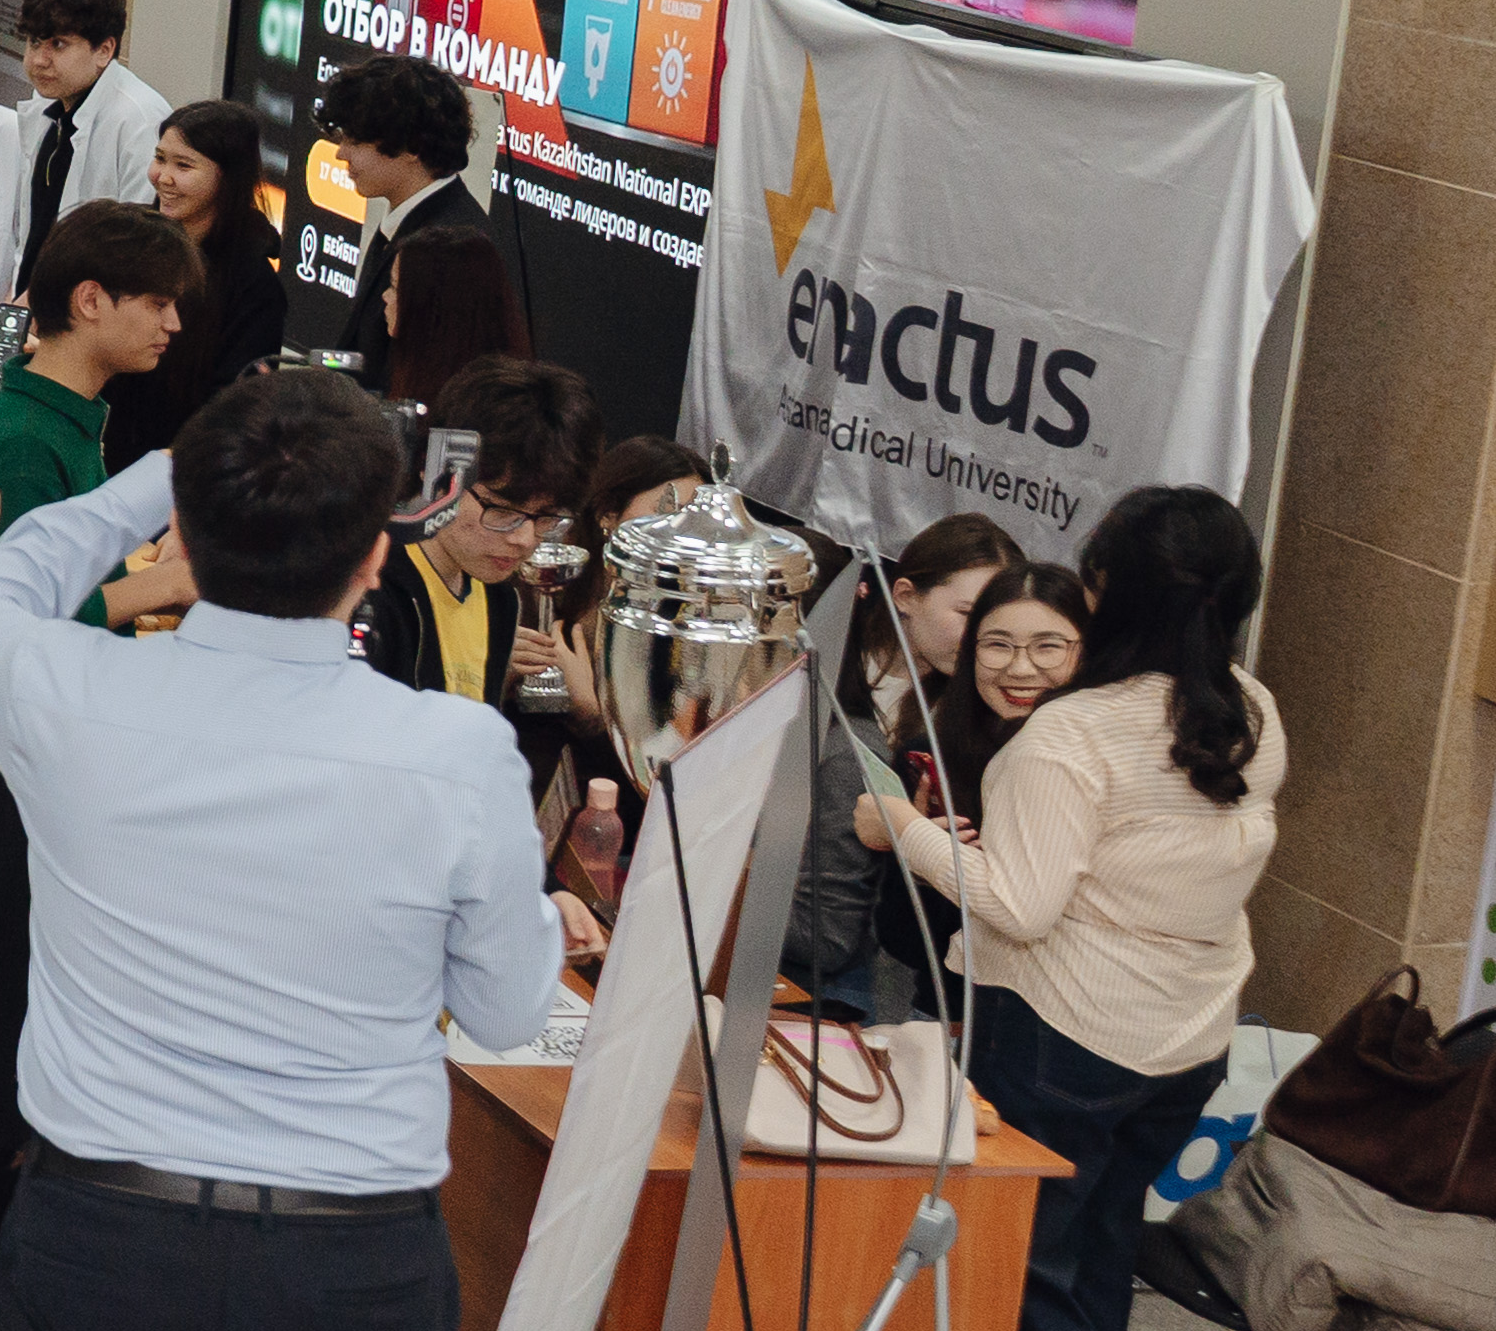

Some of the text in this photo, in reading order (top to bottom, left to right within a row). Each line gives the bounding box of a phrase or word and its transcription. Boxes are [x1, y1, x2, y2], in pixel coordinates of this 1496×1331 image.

[408, 15, 428, 57] В
[431, 22, 567, 108] КОМАНДУ
[319, 160, 331, 181] 17
[496, 124, 532, 156] atus
[532, 130, 613, 185] Kazakhstan
[613, 158, 679, 208] National
[678, 180, 714, 218] EXP
[571, 199, 638, 242] лидеров
[638, 223, 651, 248] и
[787, 268, 1098, 449] enactus
[830, 415, 915, 468] dical
[925, 437, 1081, 532] University
